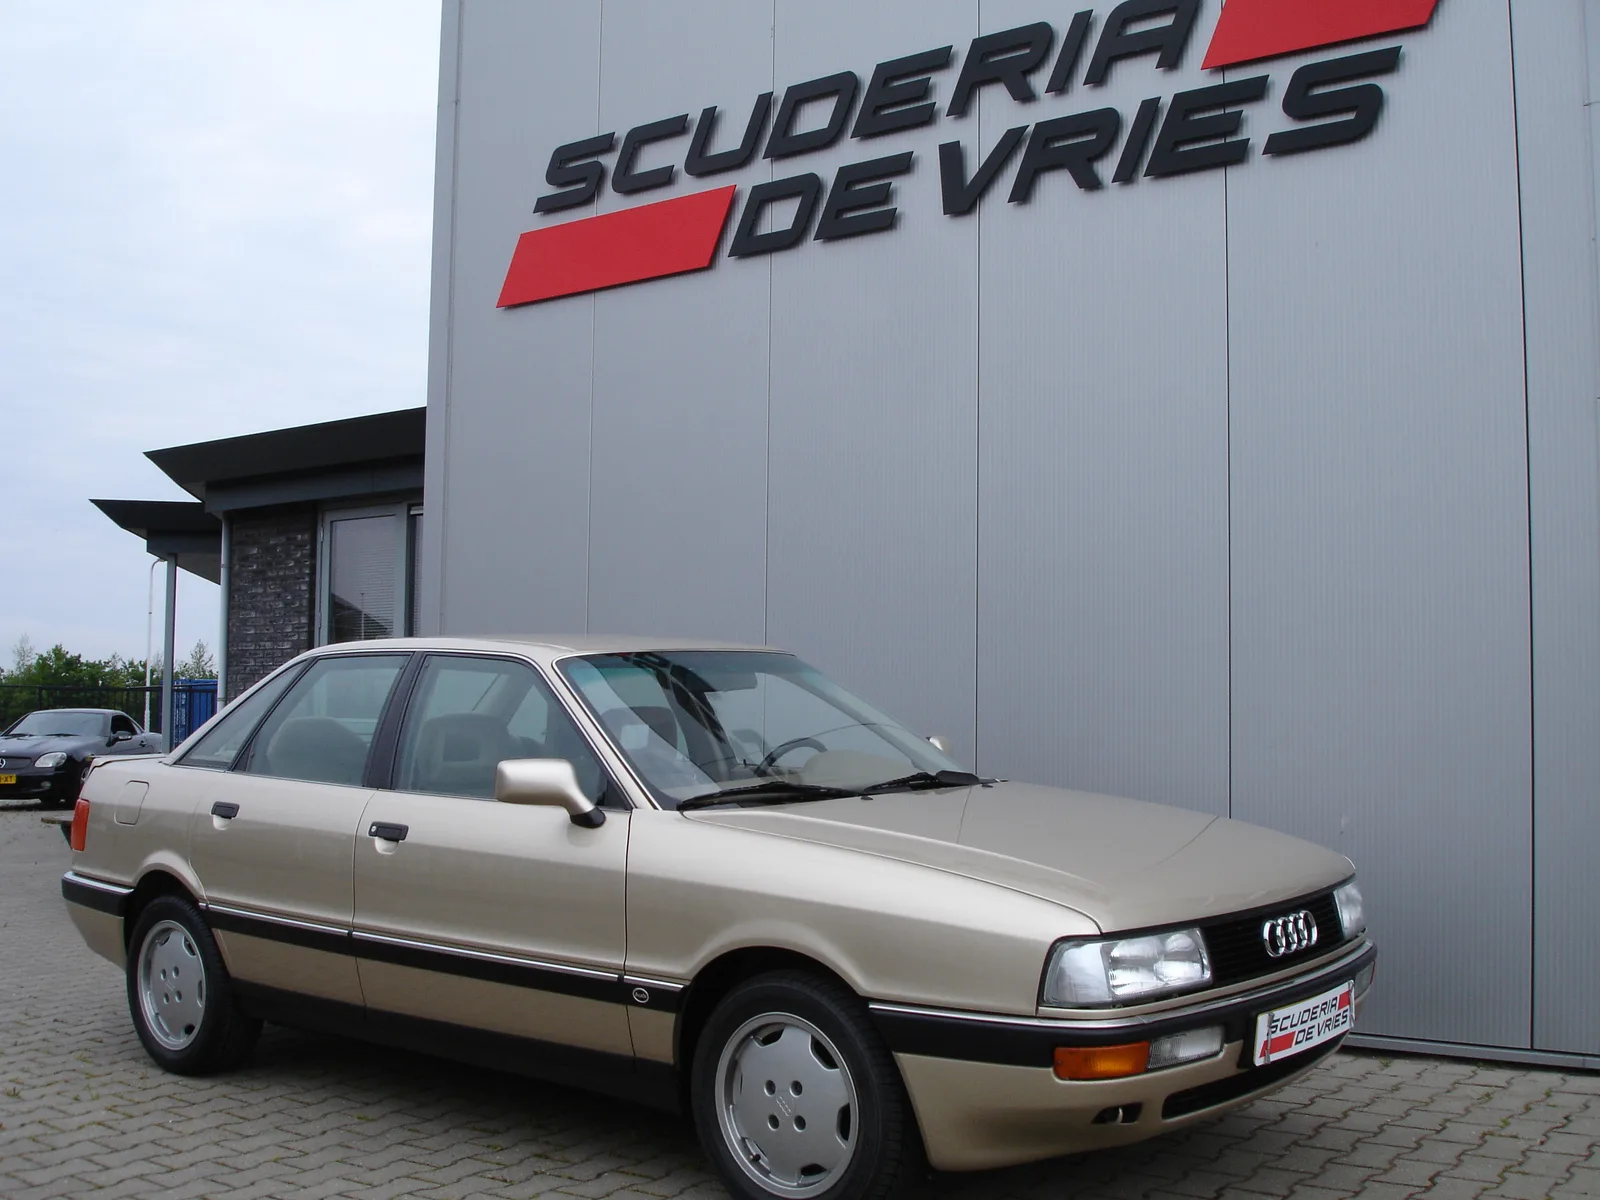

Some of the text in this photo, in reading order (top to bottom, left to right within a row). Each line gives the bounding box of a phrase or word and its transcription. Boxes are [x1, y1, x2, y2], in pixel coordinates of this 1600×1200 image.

[533, 0, 1198, 214] SCUDERIA
[728, 45, 1403, 257] DE VRIES
[1267, 996, 1338, 1036] SCUDERIA
[1294, 1008, 1349, 1046] DE VRIES
